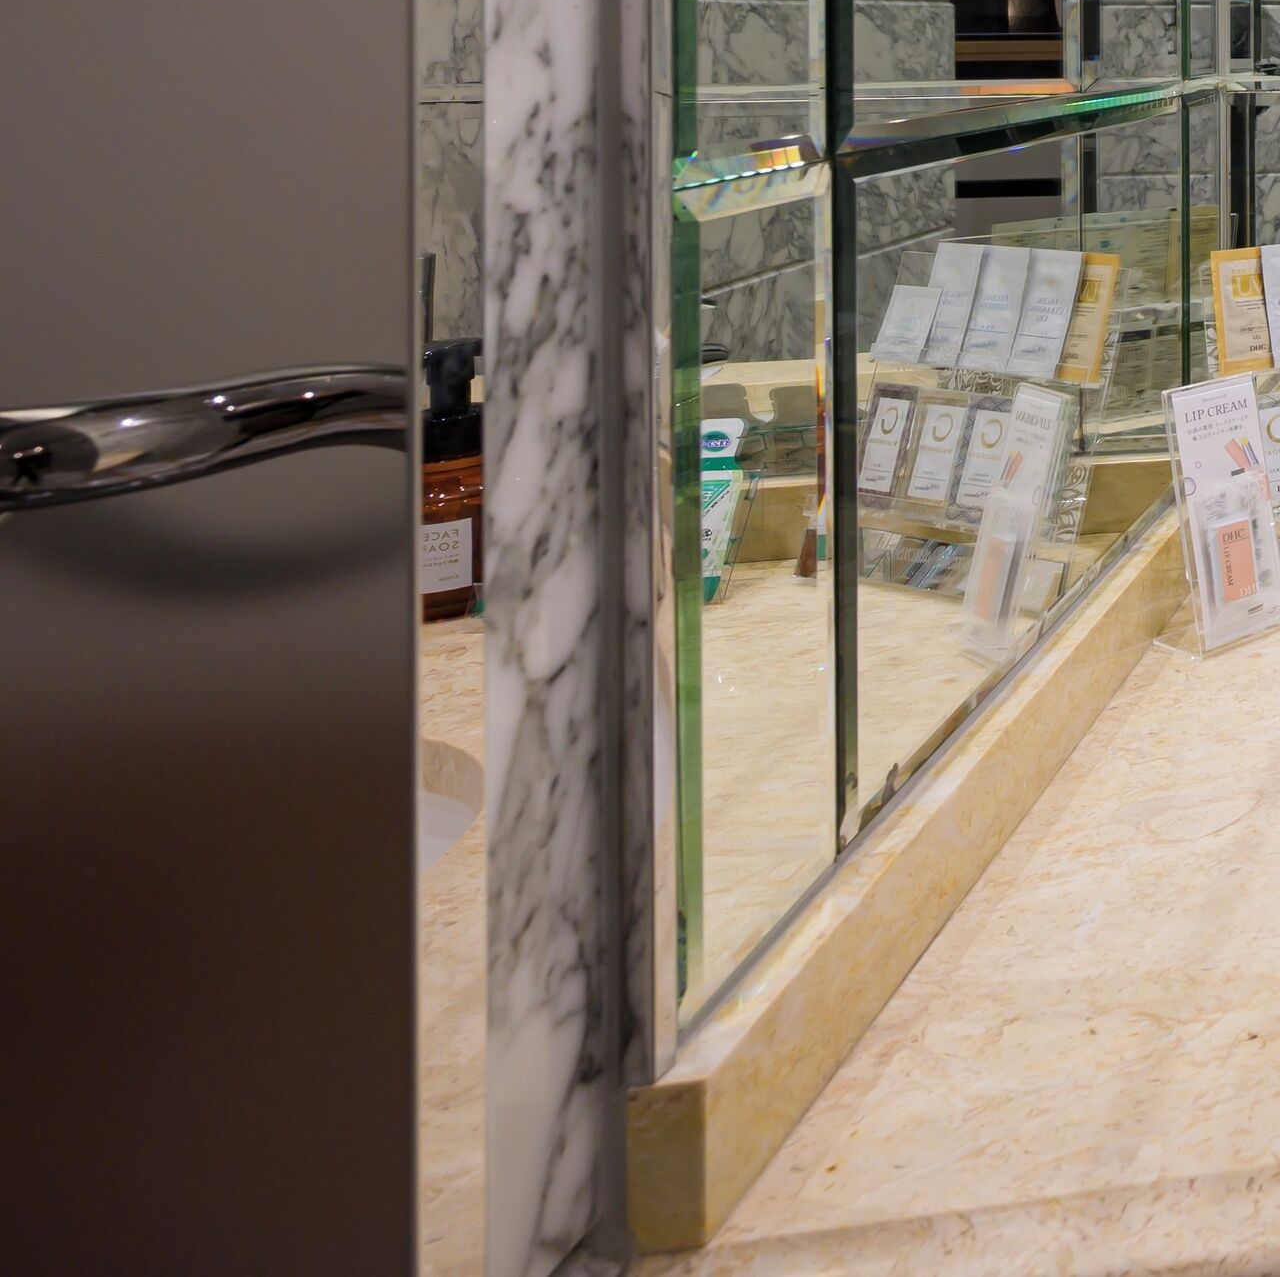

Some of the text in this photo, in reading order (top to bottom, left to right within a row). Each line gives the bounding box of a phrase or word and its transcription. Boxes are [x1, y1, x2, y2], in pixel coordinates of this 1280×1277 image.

[1250, 344, 1267, 352] DHC
[1185, 409, 1205, 423] LIP
[1207, 398, 1248, 418] CREAM
[1222, 528, 1245, 542] DHC
[1223, 545, 1234, 587] LIP CREAM
[1239, 584, 1257, 597] DH
